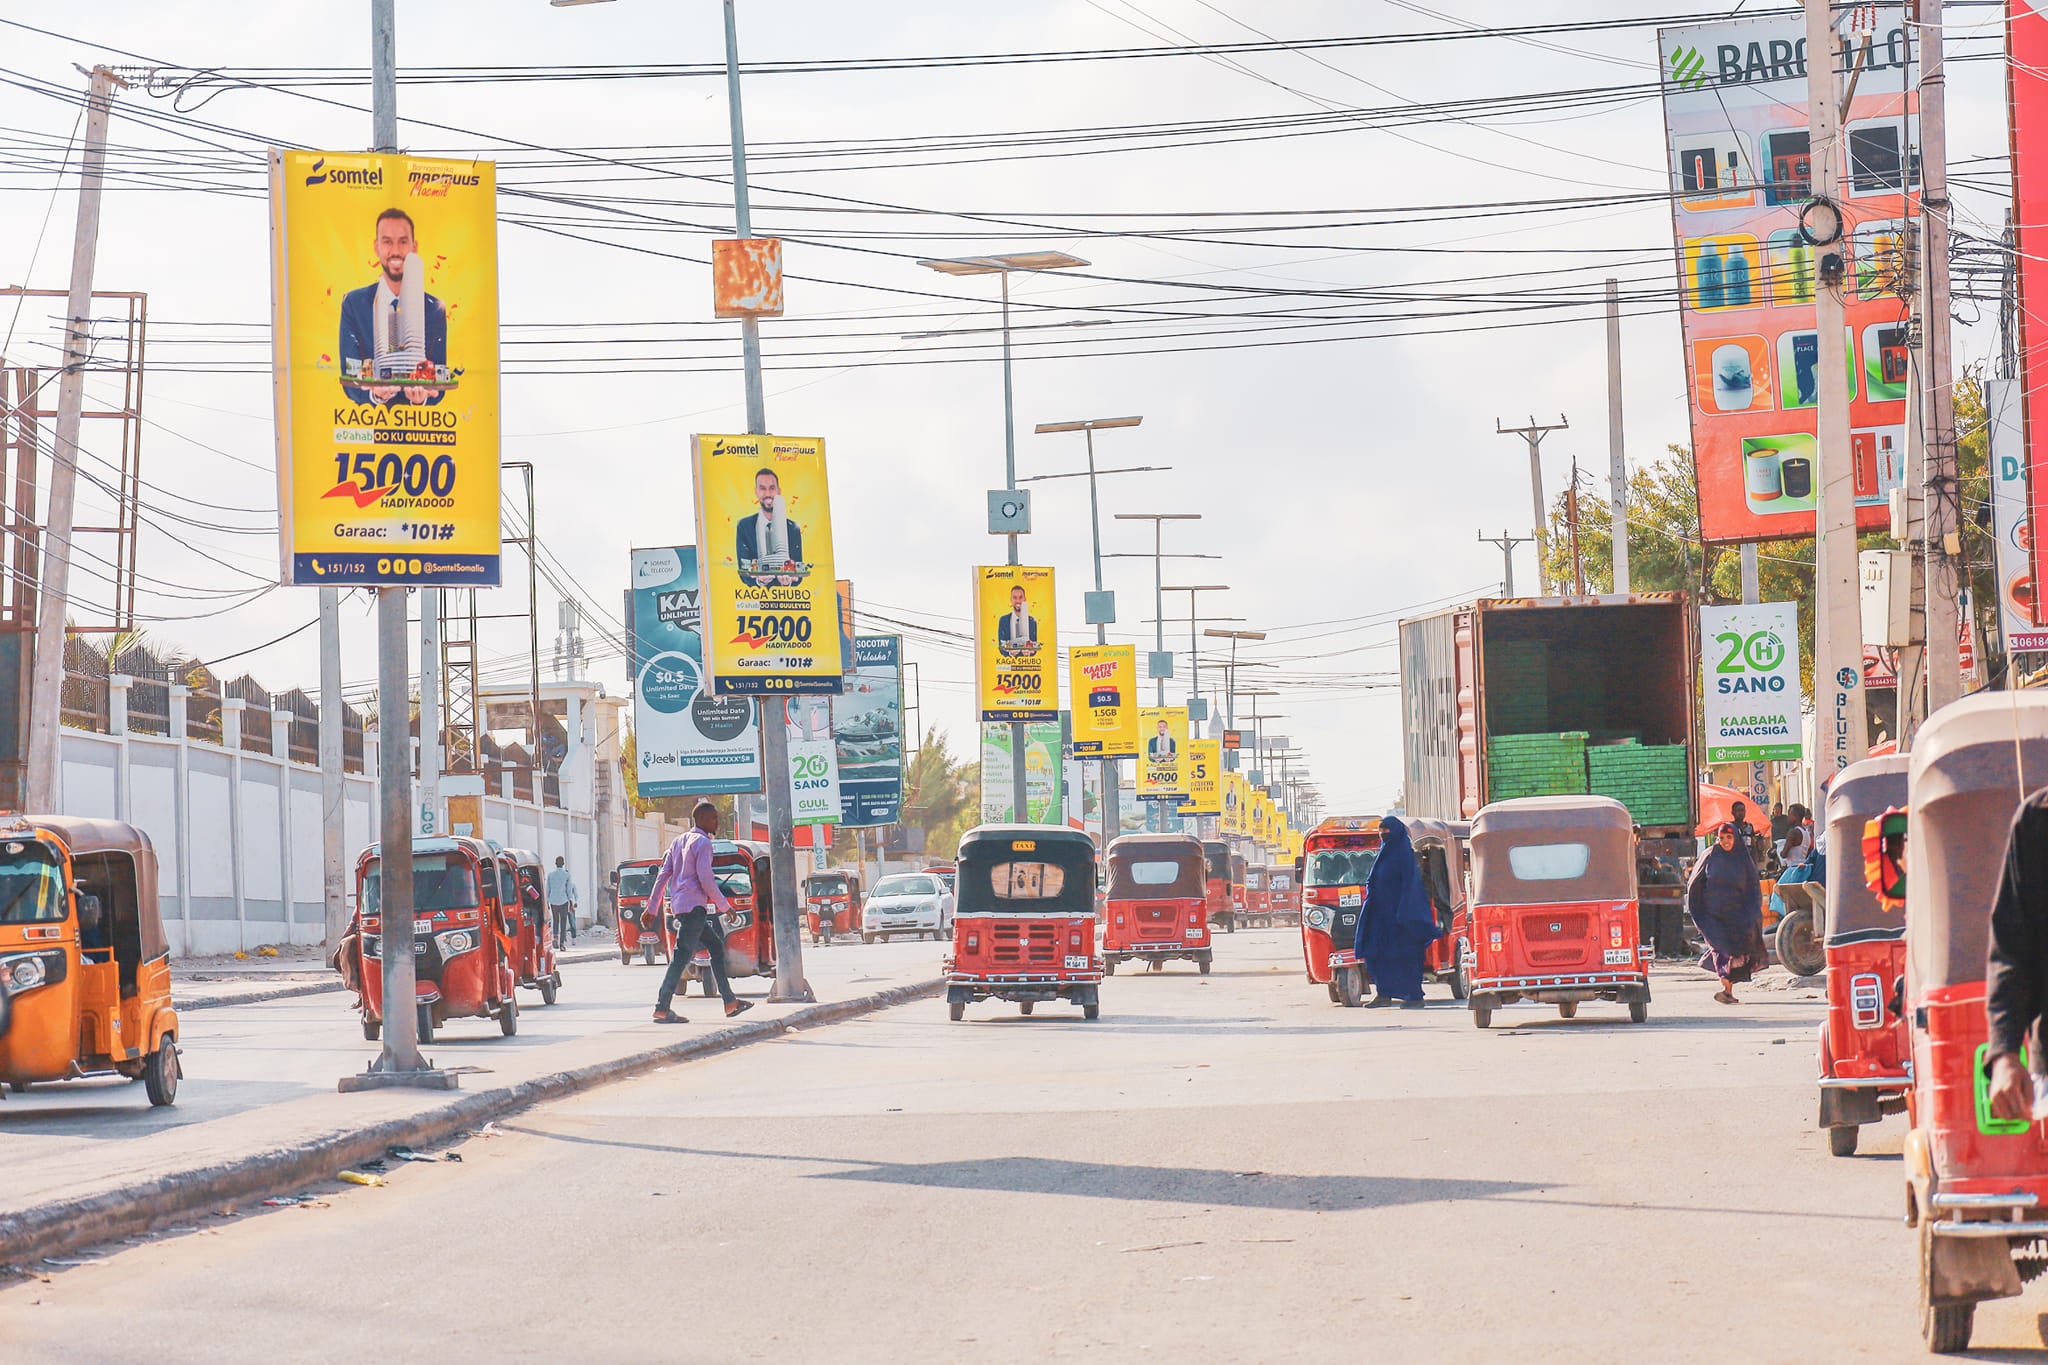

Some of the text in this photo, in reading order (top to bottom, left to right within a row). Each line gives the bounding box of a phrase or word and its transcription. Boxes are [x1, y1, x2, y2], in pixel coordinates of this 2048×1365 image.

[1717, 29, 1912, 85] BARLLO
[329, 167, 383, 185] somtel
[334, 408, 457, 428] KAGA SHUBO
[391, 432, 403, 442] KU
[405, 433, 455, 443] GUULEYSO
[726, 443, 759, 455] somtel
[334, 452, 456, 498] 15000
[380, 498, 455, 508] HADIYADOOD
[334, 523, 387, 538] Garaac:
[327, 563, 365, 574] 151/152
[735, 589, 811, 600] KAGA SHUBO
[736, 615, 812, 642] 15000
[856, 639, 889, 648] SOCOTAY
[737, 658, 771, 667] Garaac:
[996, 657, 1042, 665] KAGA SHUBO
[1083, 661, 1117, 675] KAAFIYE
[1090, 670, 1112, 680] PLUS
[996, 674, 1041, 690] 15000
[1718, 675, 1785, 694] SANO
[646, 685, 677, 693] Unlimited
[1096, 695, 1112, 703] $0.5
[1094, 708, 1117, 718] 1.5GB
[1721, 715, 1787, 726] KAABAHA
[1720, 726, 1789, 737] GANACSIGA
[1146, 772, 1178, 782] 15000
[794, 778, 829, 790] SANO
[798, 799, 829, 809] GUUL
